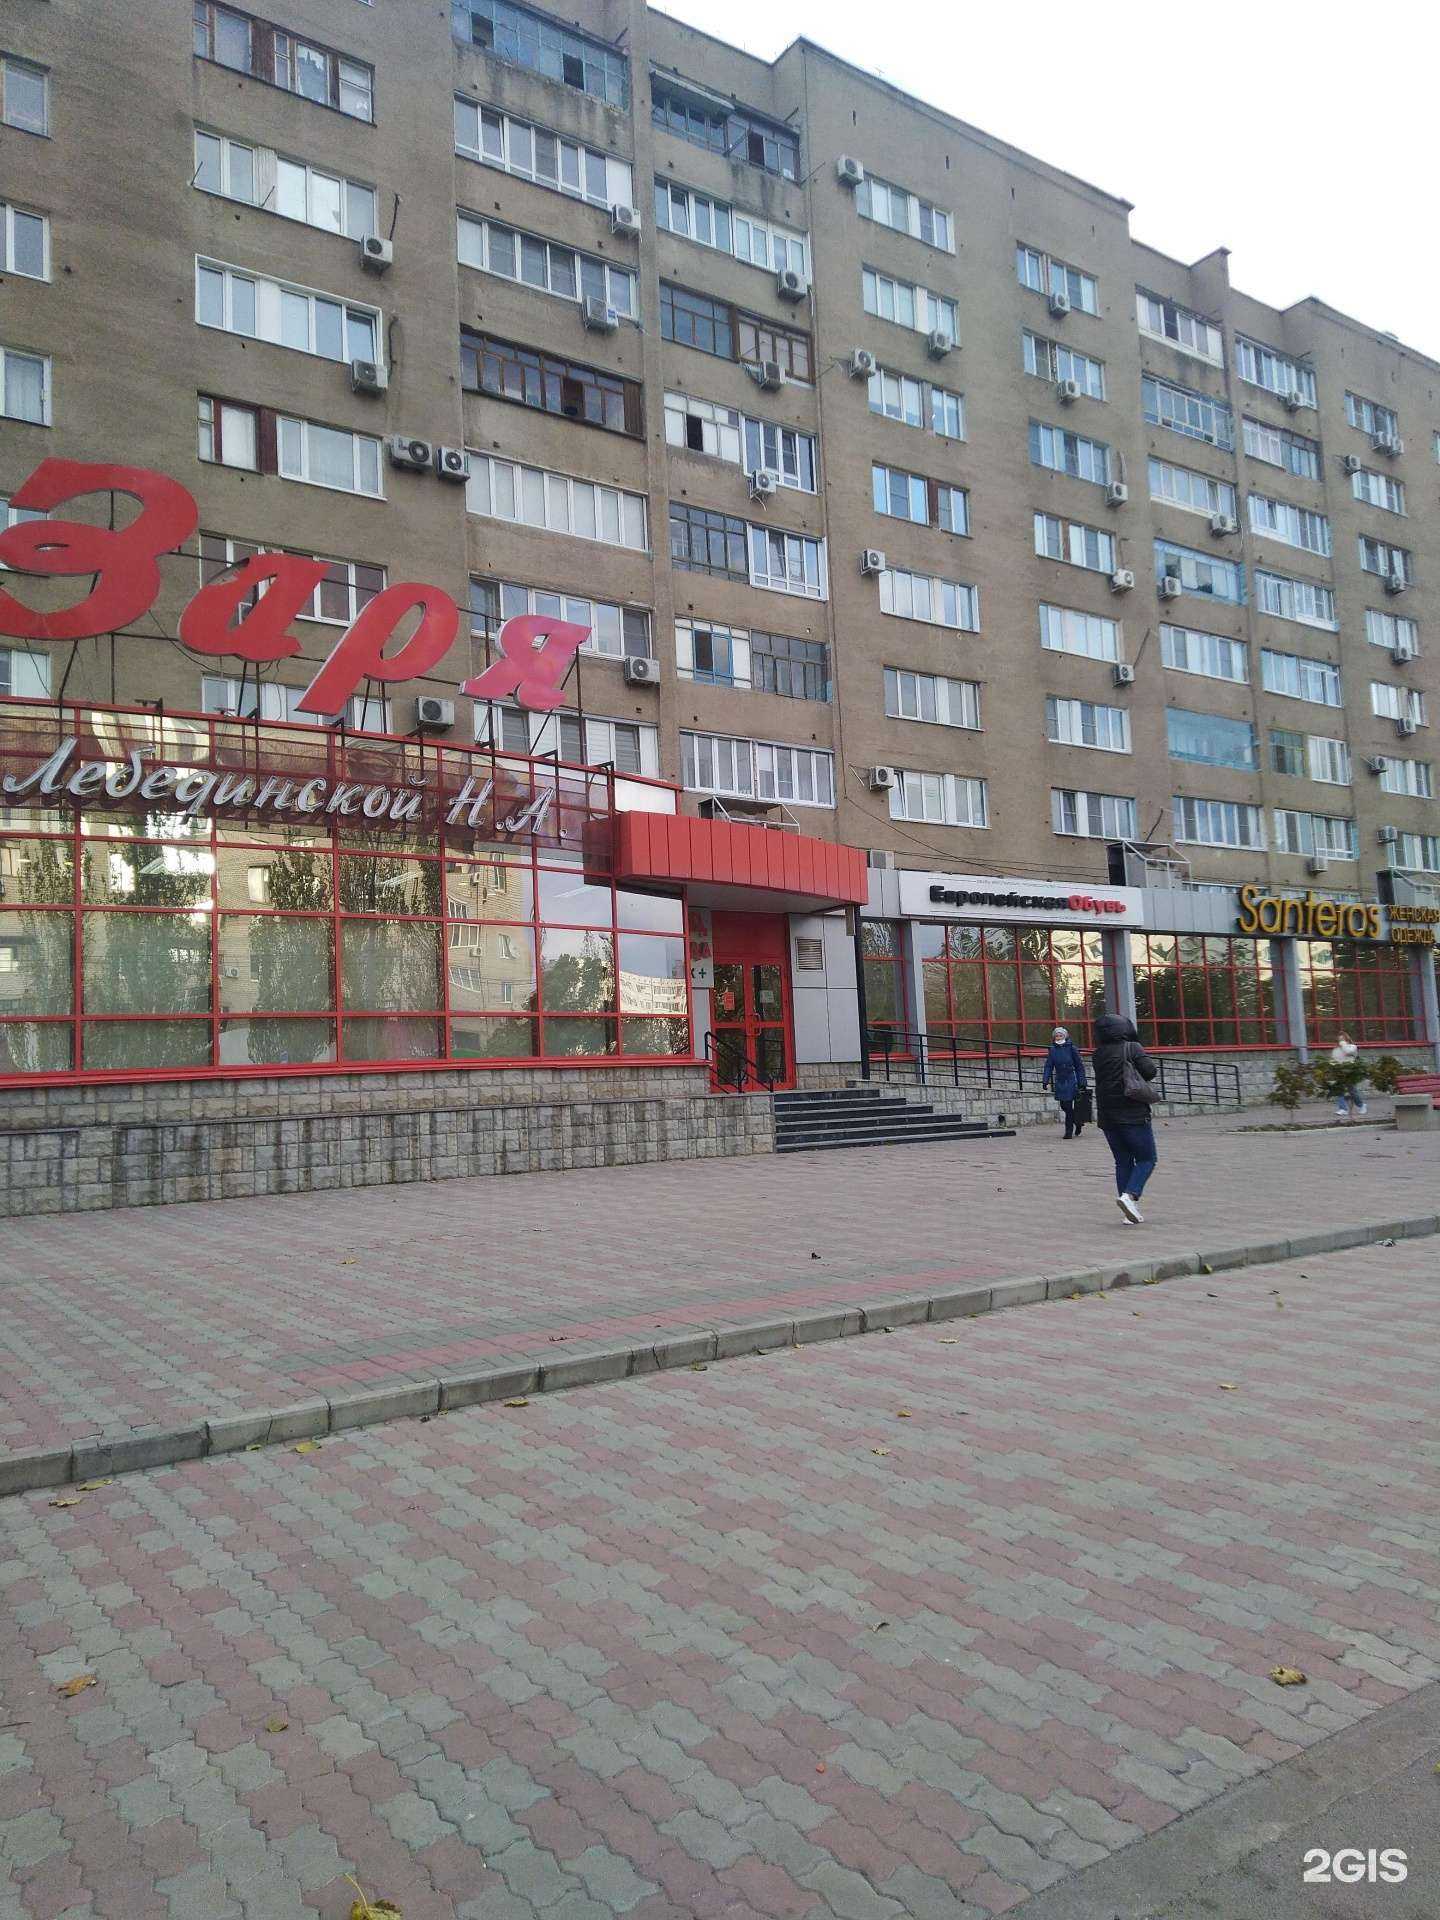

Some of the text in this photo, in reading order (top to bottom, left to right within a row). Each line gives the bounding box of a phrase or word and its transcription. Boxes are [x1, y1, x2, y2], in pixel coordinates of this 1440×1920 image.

[0, 457, 592, 714] Заря
[2, 735, 430, 825] Лебединской
[1238, 883, 1381, 938] Santeros
[1388, 905, 1440, 923] ЖЕНСКАЯ
[1391, 927, 1436, 945] ОДЕЖДА
